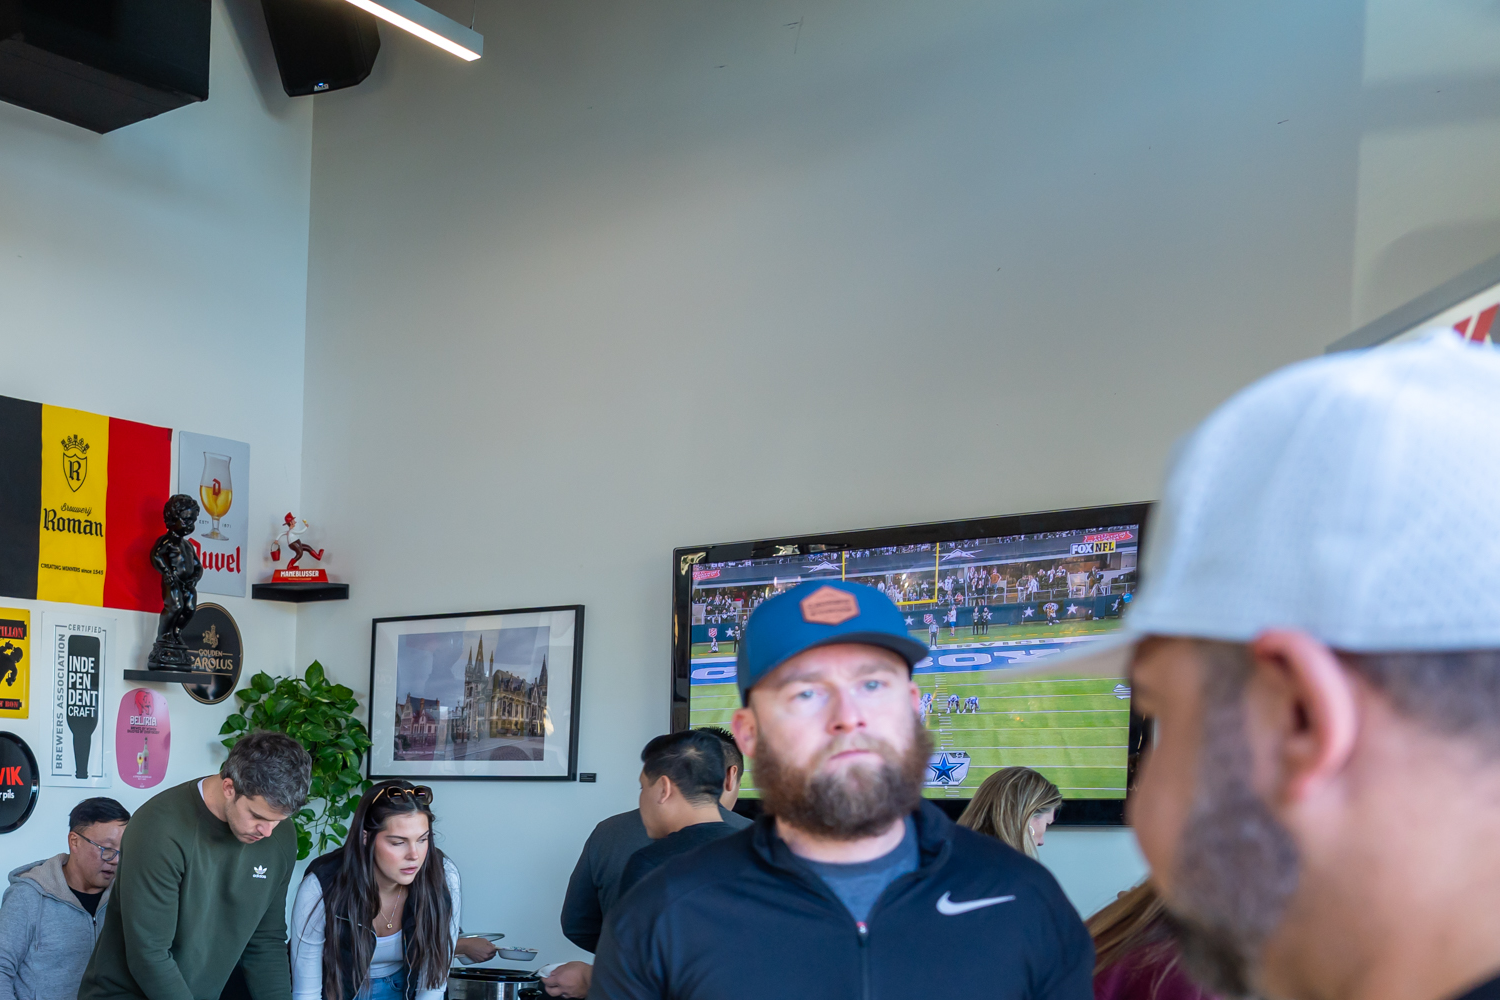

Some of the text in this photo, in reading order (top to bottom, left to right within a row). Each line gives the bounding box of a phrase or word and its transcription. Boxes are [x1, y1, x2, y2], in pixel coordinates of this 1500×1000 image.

[60, 502, 92, 517] Brouwerij
[43, 508, 103, 538] Roman
[1071, 541, 1115, 555] FOX NFL
[67, 623, 102, 634] CERTIFIED
[198, 648, 223, 657] GOUDEN
[68, 655, 95, 673] INDE
[68, 673, 91, 689] PEN
[4, 700, 18, 708] BON
[55, 633, 65, 769] BREWERS ASSOCIATION
[68, 689, 98, 706] DENT
[67, 706, 95, 718] CRAFT
[2, 788, 15, 801] pils
